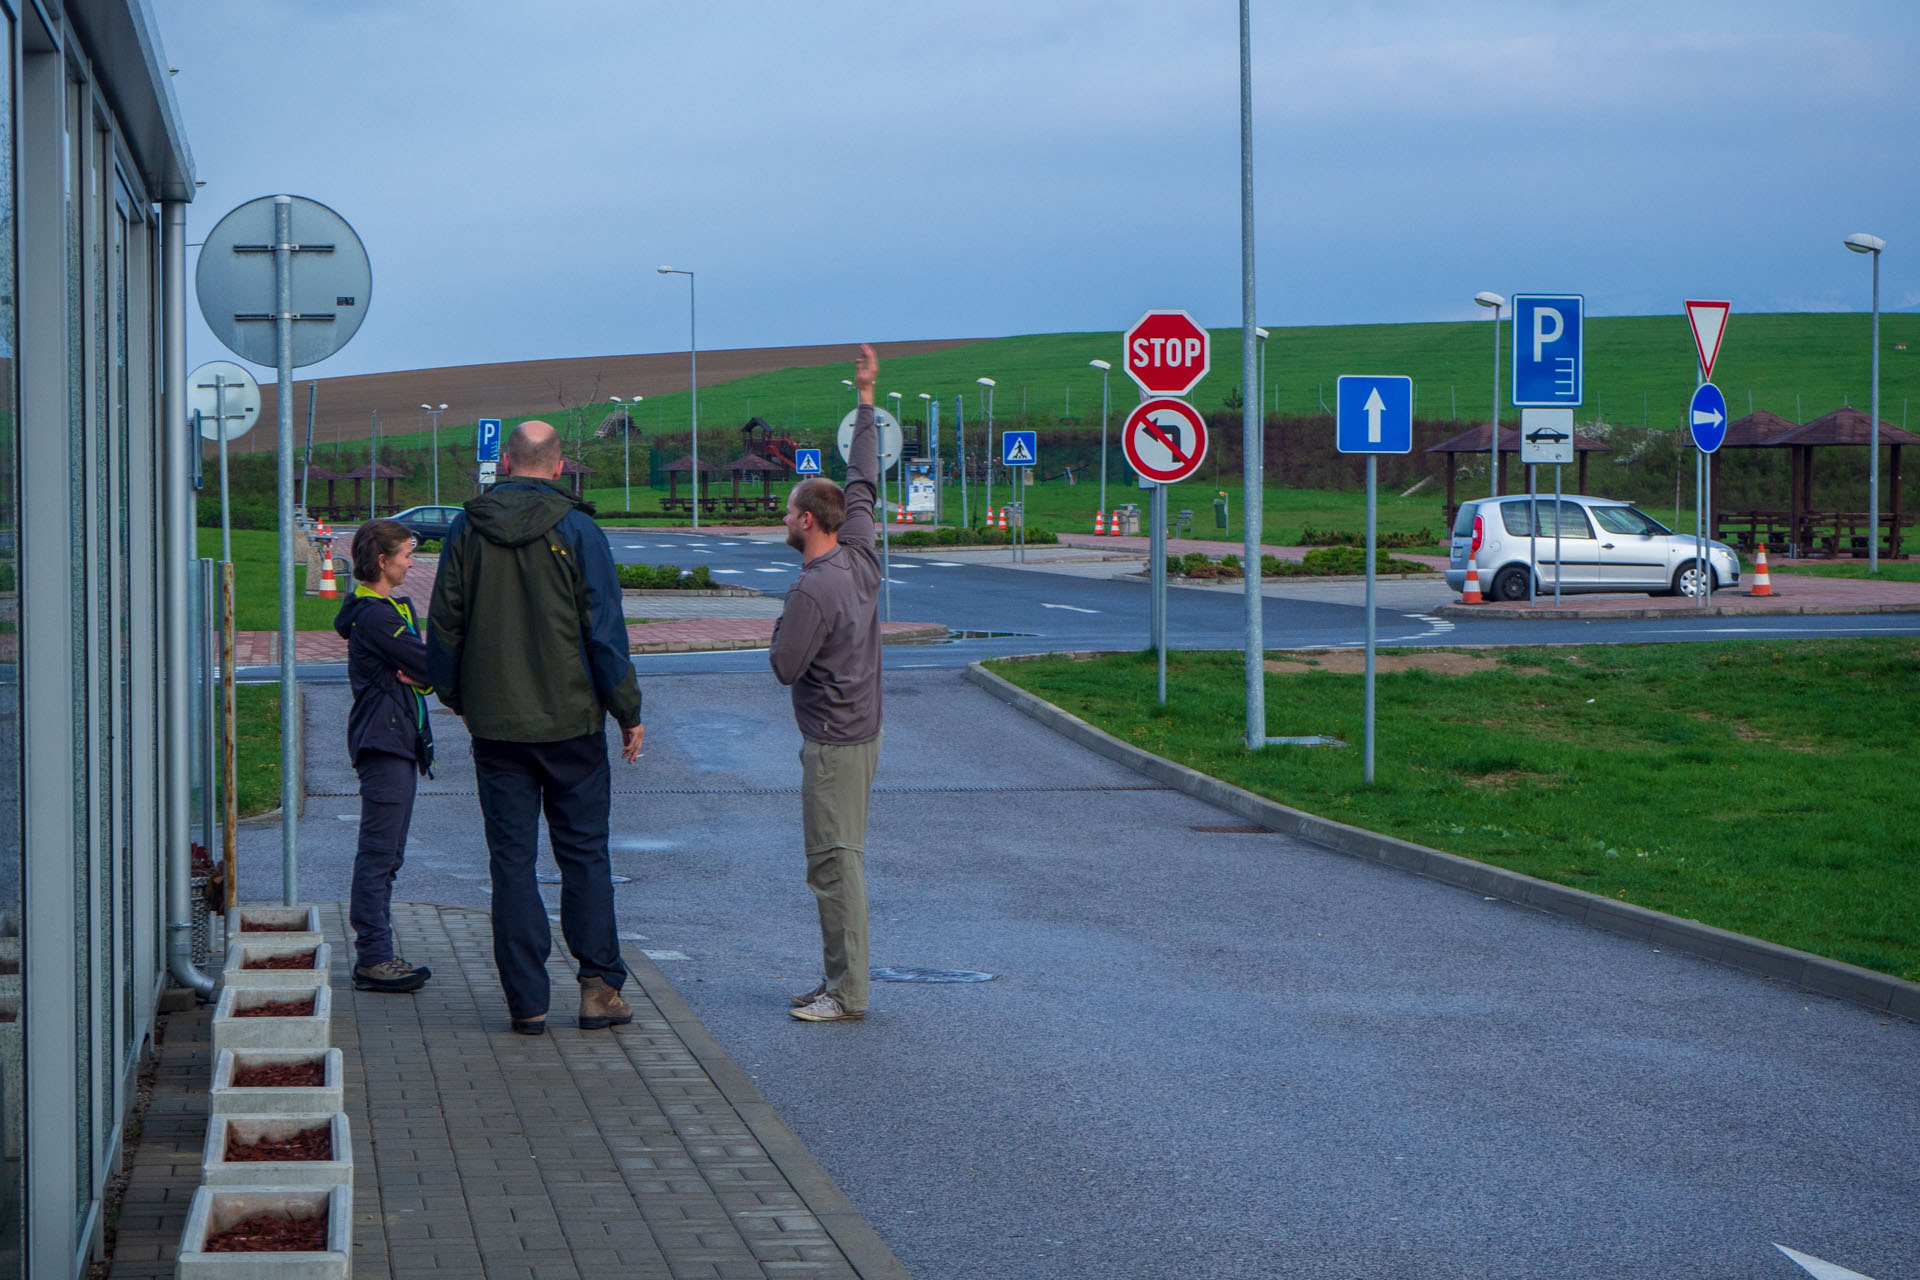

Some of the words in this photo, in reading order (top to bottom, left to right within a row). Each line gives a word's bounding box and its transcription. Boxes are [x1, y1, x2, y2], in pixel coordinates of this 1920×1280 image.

[1533, 307, 1564, 362] P
[1133, 338, 1201, 367] STOP
[484, 423, 495, 445] P
